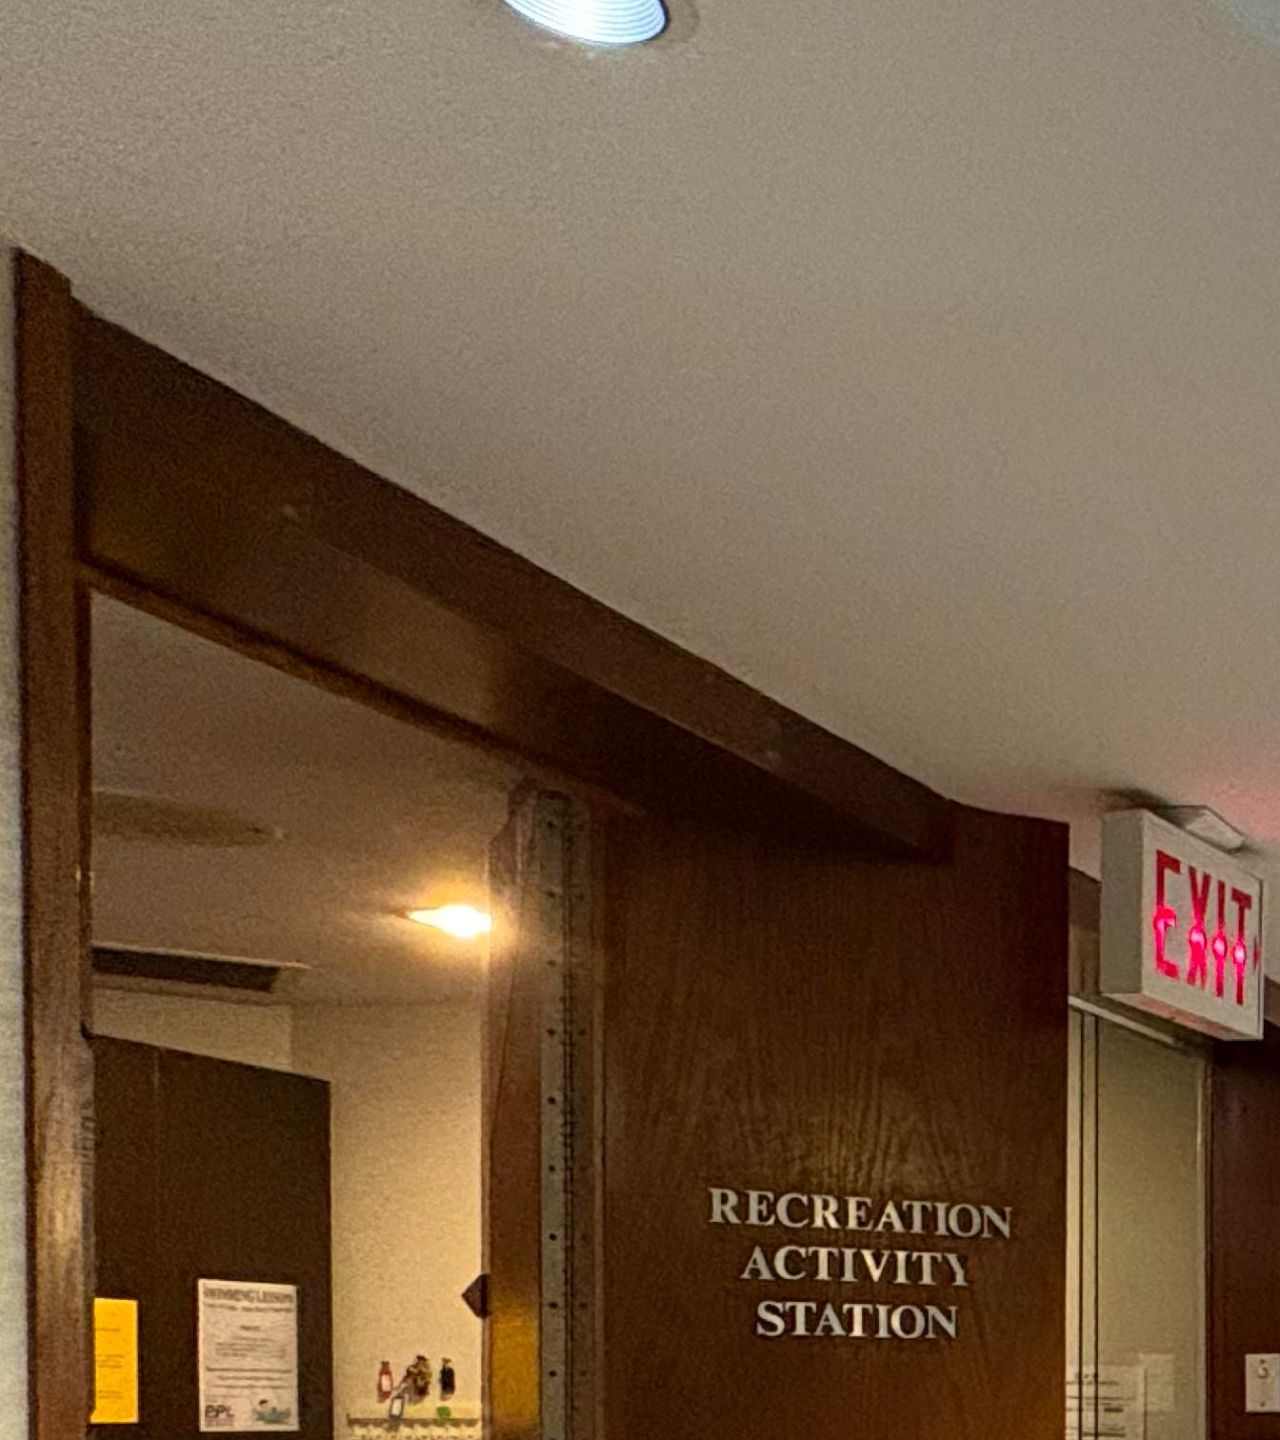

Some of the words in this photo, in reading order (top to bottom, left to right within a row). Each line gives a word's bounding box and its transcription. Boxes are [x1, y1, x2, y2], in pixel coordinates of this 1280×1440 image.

[1153, 849, 1253, 1006] EXIT
[708, 1187, 1013, 1240] RECREATION
[740, 1245, 969, 1287] ACTIVITY
[756, 1300, 959, 1339] STATION
